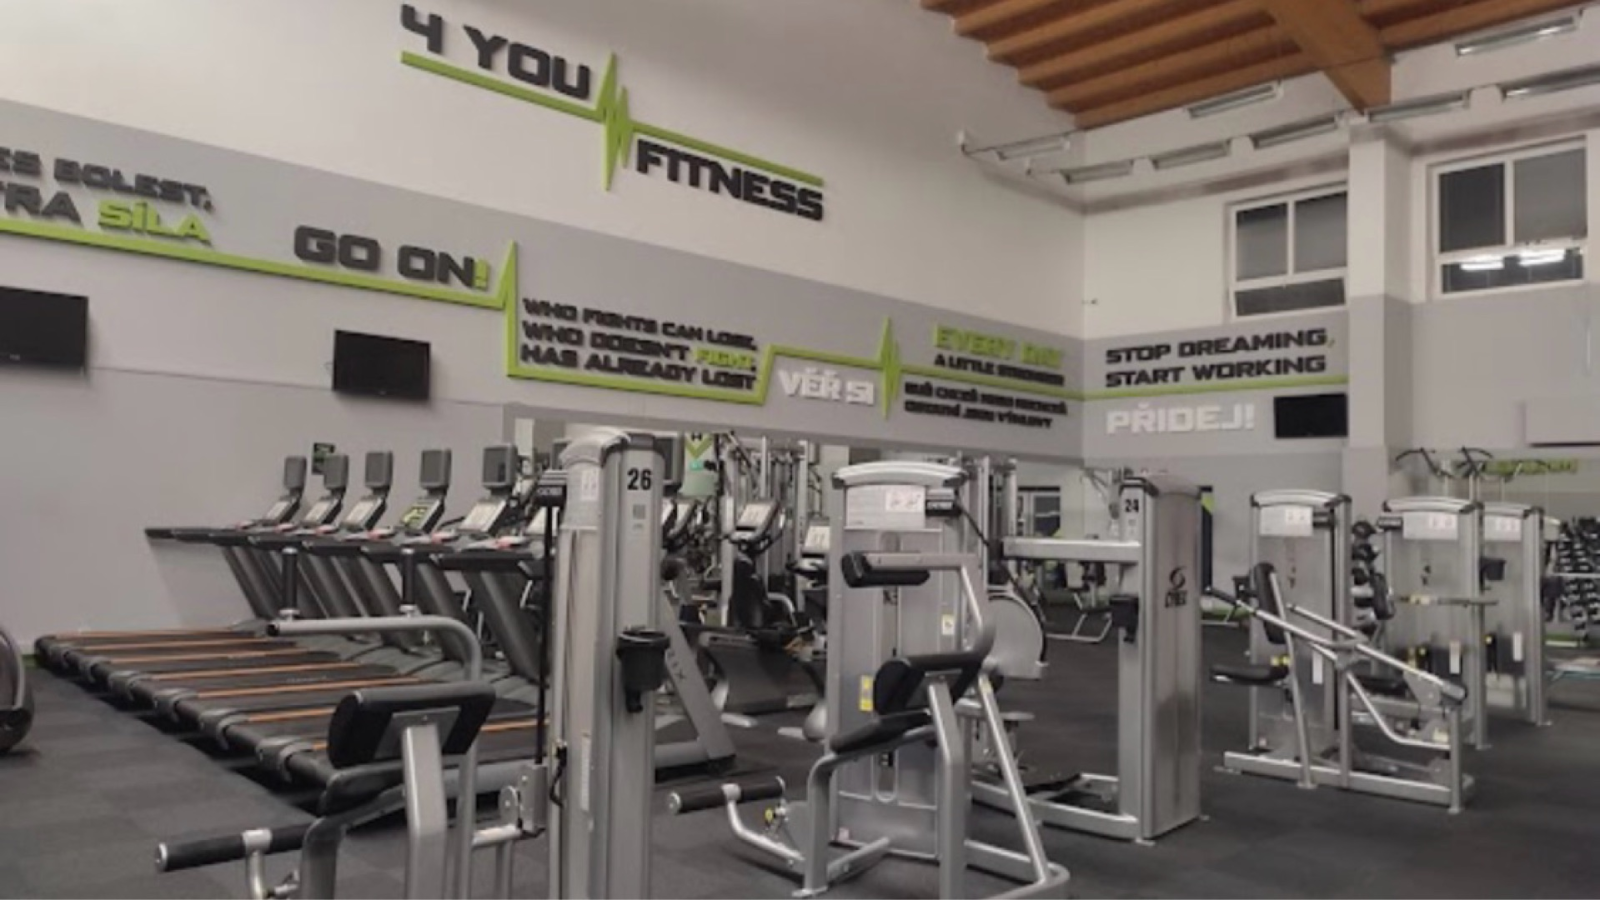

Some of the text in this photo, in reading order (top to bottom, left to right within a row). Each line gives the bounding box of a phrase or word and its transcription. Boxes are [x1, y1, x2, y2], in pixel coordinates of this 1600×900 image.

[402, 4, 591, 99] 4 YOU
[54, 157, 213, 211] BOLEST,
[637, 139, 824, 221] FITNESS
[0, 180, 83, 225] RA
[294, 225, 490, 290] GO ON!
[522, 320, 584, 346] WHO
[523, 298, 577, 321] WHO
[583, 308, 657, 334] FIGHTS
[662, 322, 702, 341] CAN
[934, 324, 1016, 360] EVERY
[934, 353, 946, 367] A
[1106, 343, 1171, 365] STOP
[521, 344, 757, 390] HAS ALREADY LOST
[1106, 355, 1326, 389] START WORKING
[1106, 402, 1255, 435] PŘIDEJ!
[627, 468, 653, 491] 26
[1125, 498, 1140, 514] 24
